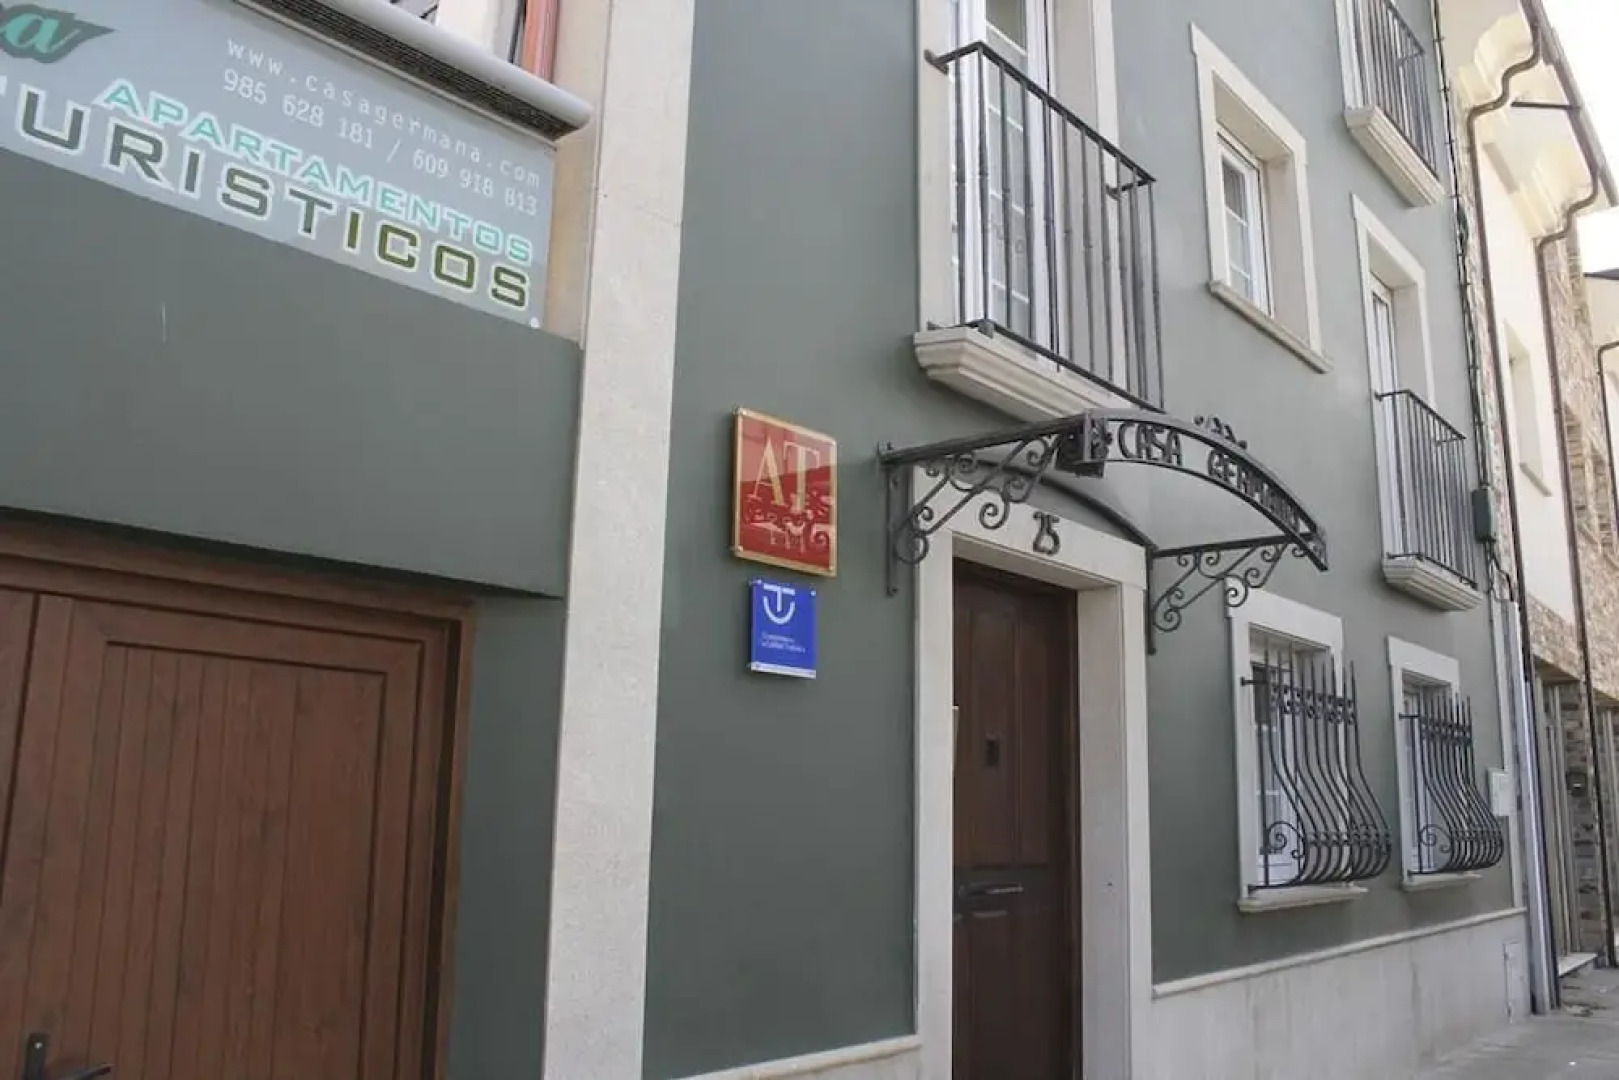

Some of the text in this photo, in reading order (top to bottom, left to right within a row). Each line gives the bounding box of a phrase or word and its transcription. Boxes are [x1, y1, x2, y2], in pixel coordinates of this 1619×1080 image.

[92, 79, 534, 264] APARTAMENTOS
[223, 68, 537, 216] 985 628 181 / 609 918 813
[227, 38, 541, 189] www.casagermana.com
[0, 76, 532, 310] URISTICOS
[747, 435, 820, 514] AT
[1117, 420, 1183, 467] CASA
[1032, 511, 1060, 557] 25
